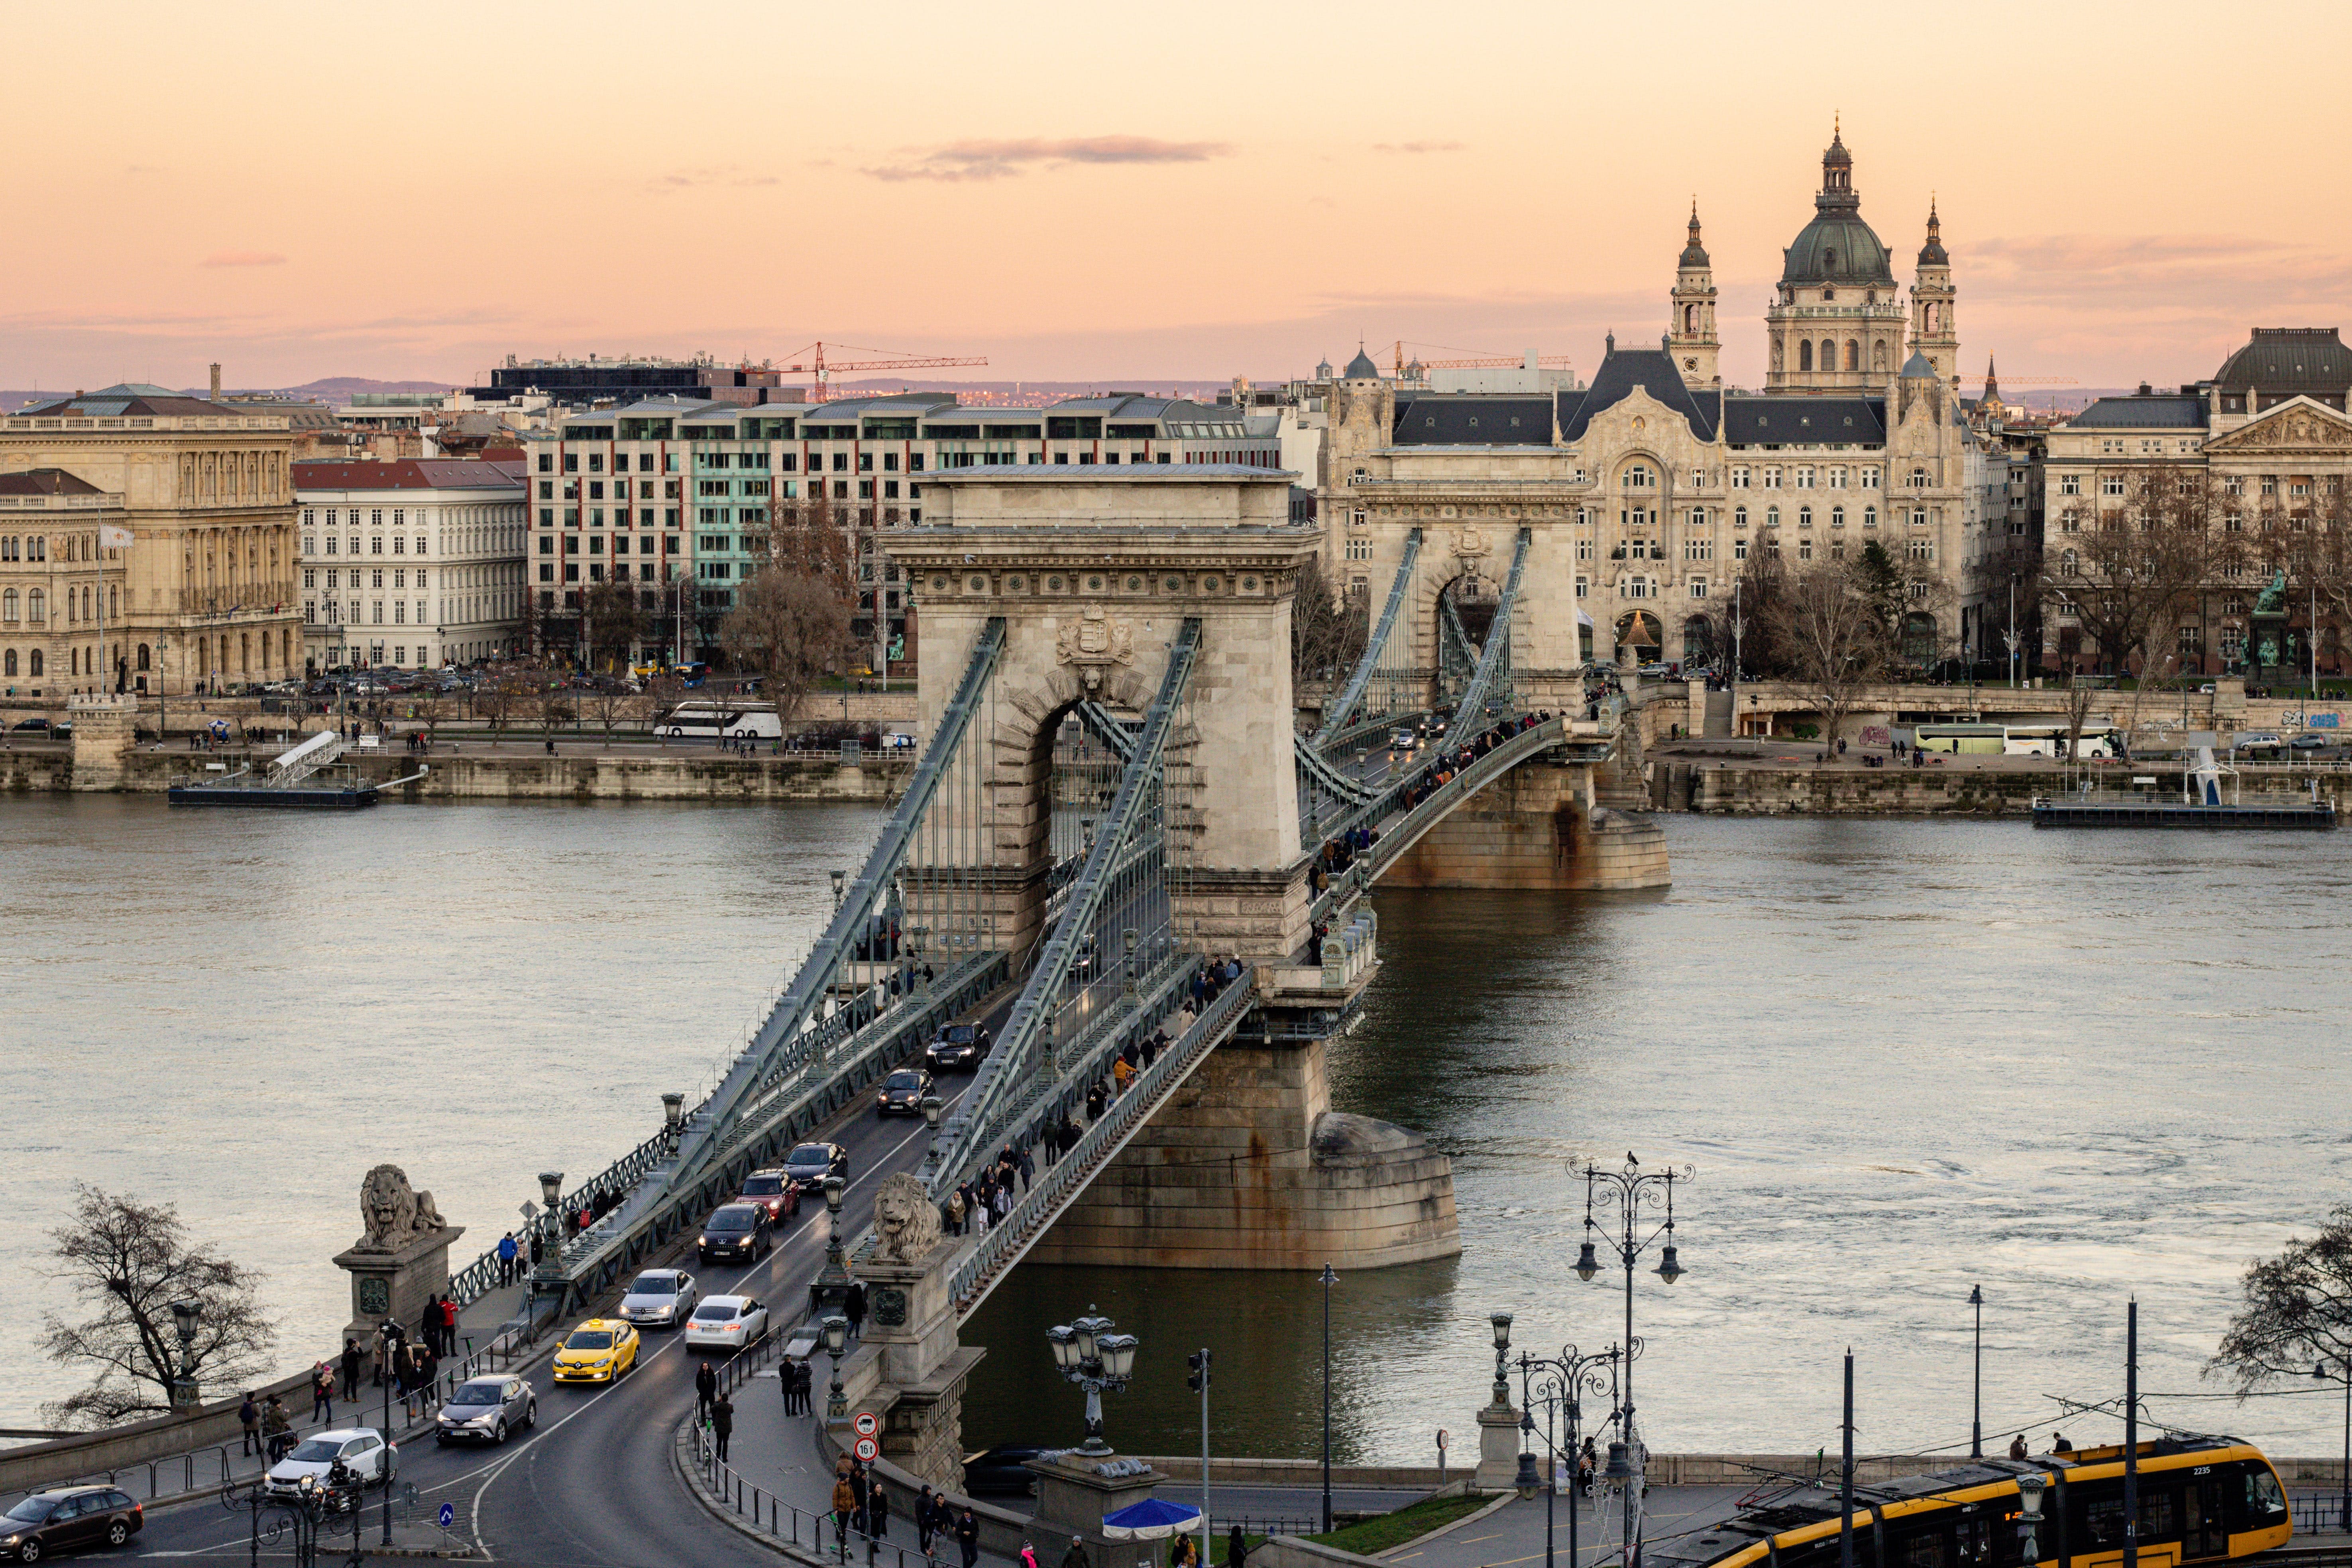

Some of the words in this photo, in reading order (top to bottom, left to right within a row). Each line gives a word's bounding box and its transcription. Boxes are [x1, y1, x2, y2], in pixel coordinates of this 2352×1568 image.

[1442, 1435, 1447, 1444] 50
[860, 1444, 868, 1454] 16
[870, 1445, 872, 1454] t
[2194, 1466, 2211, 1475] 2235
